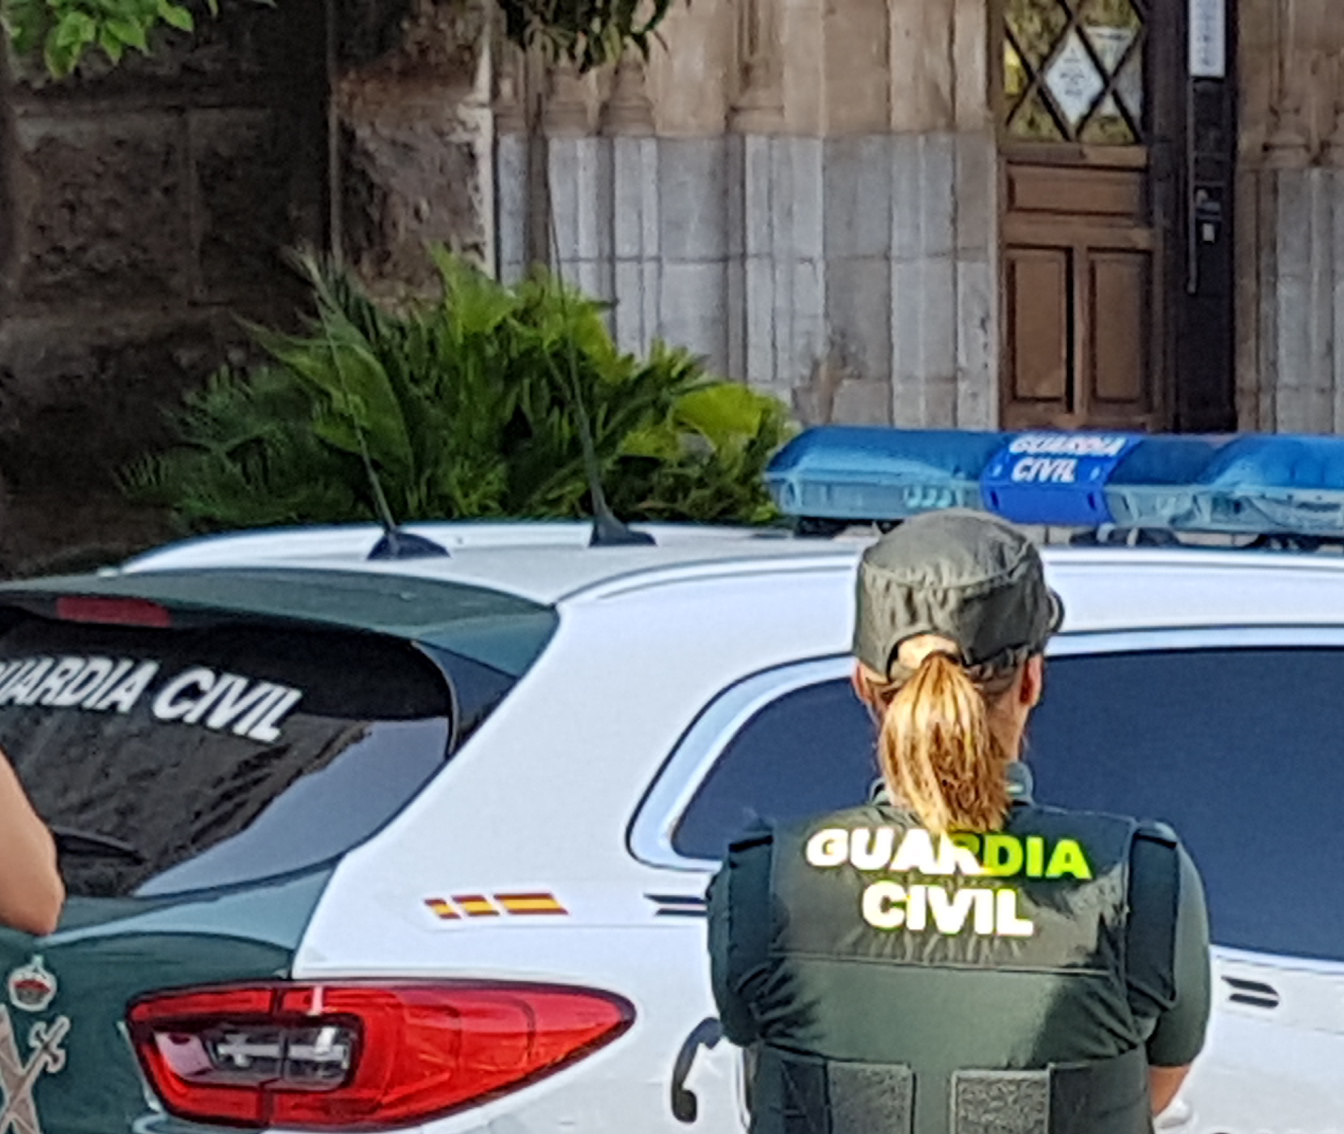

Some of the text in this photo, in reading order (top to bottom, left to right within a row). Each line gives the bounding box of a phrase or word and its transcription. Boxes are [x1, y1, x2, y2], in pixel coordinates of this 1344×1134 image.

[1009, 434, 1126, 456] GUARDIA
[1011, 456, 1078, 483] CIVIL
[152, 666, 302, 743] CIVIL
[805, 827, 1093, 879] GUARDIA
[861, 880, 1034, 937] CIVIL
